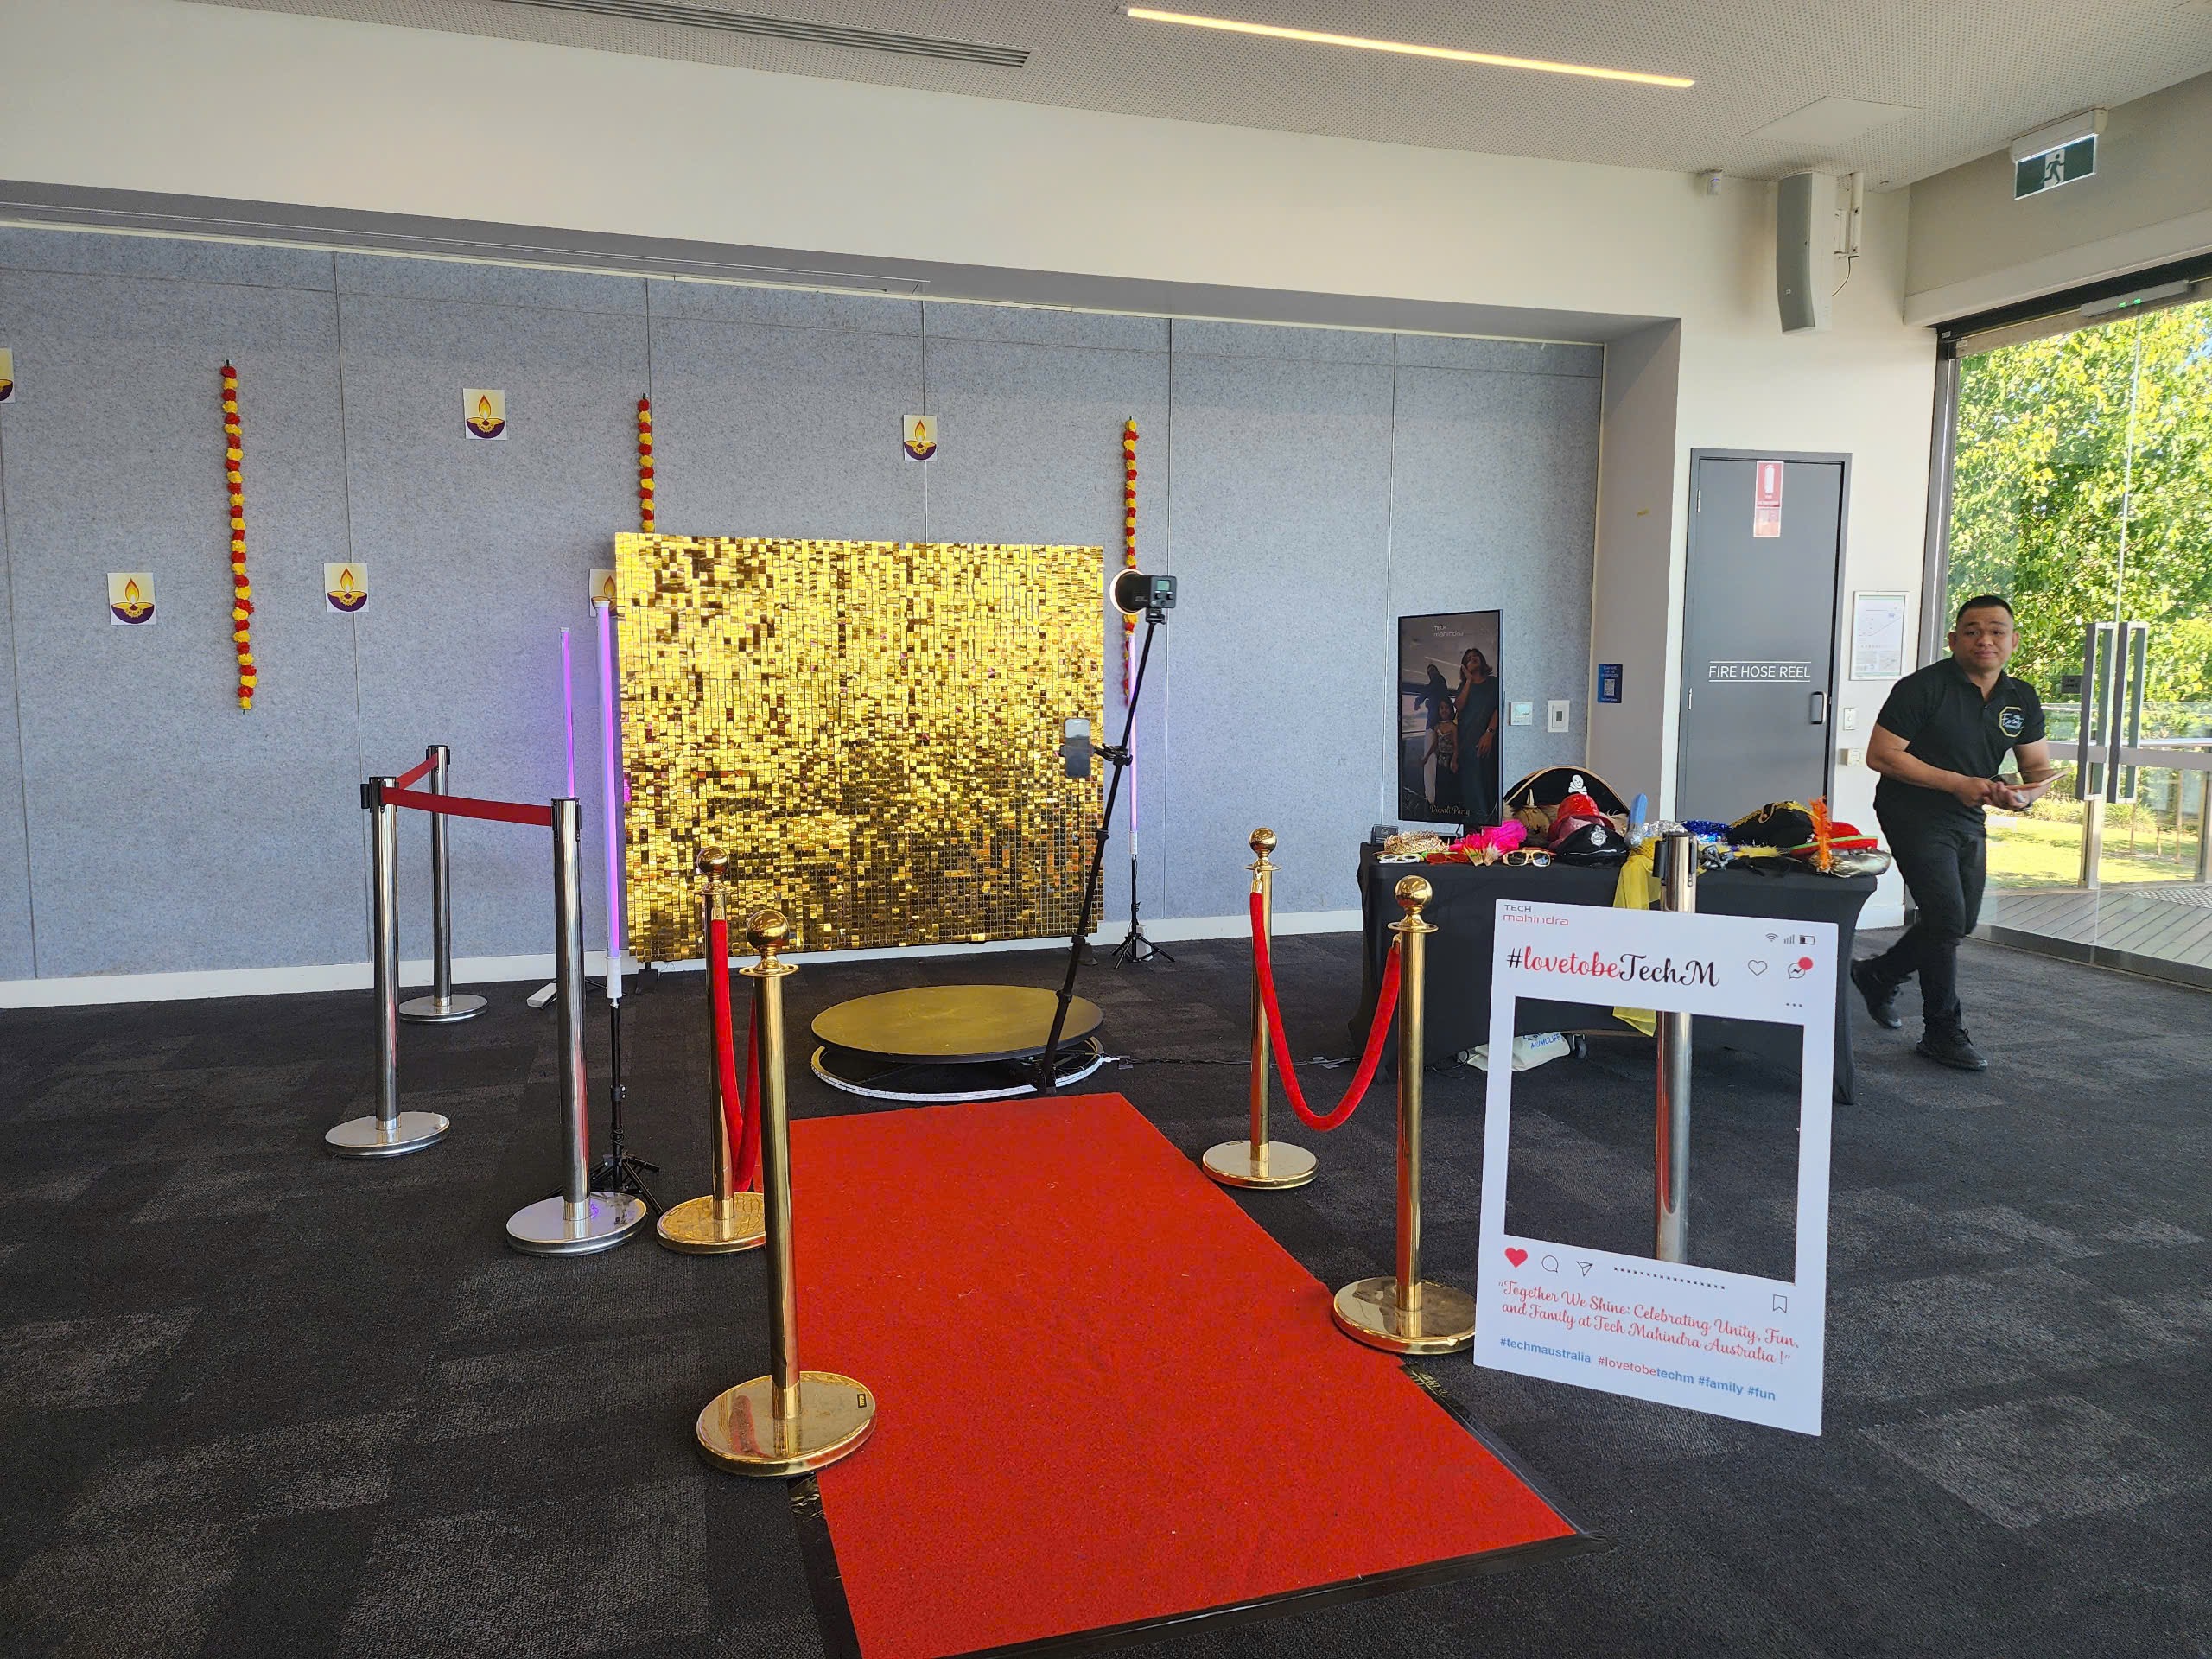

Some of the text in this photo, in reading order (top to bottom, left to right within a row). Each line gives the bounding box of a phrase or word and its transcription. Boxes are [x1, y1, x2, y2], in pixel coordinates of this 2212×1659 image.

[1708, 665, 1811, 678] FIRE HOSE REEL
[1503, 914, 1569, 926] mahindra
[1504, 904, 1532, 912] TECH
[1506, 945, 1720, 987] #lovetobeTechM
[1530, 1033, 1562, 1050] MUMULIFE
[1561, 1291, 1587, 1307] We
[1589, 1295, 1630, 1315] Shine:
[1633, 1304, 1712, 1337] Celebrating
[1502, 1302, 1528, 1316] and
[1529, 1303, 1576, 1331] Family
[1578, 1316, 1592, 1328] at
[1593, 1314, 1625, 1334] Tech
[1628, 1322, 1702, 1349] Mahindra
[1703, 1338, 1777, 1363] Australia
[1499, 1337, 1777, 1402] #techmaustralia #lovetobetechm #family #fun
